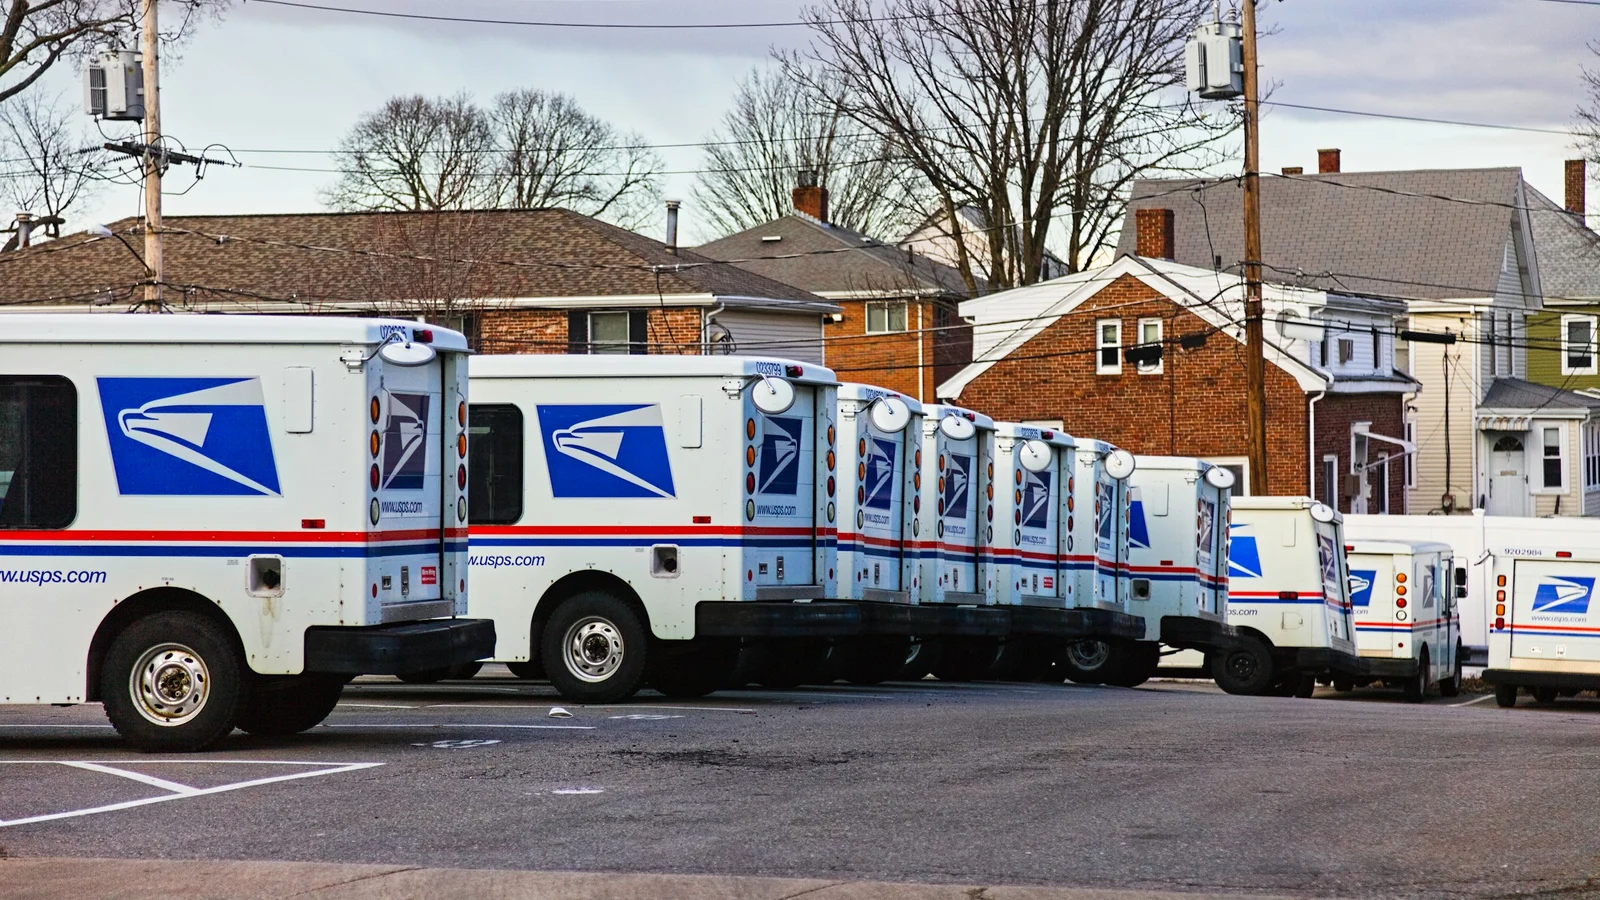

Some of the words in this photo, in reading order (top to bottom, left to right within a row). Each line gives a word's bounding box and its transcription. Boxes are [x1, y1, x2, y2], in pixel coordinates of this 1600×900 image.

[756, 361, 781, 376] 0233799
[381, 501, 422, 516] www.usps.com
[757, 504, 796, 518] www.usps.com
[1504, 548, 1542, 556] 9202984
[1531, 615, 1587, 623] www.usps.com
